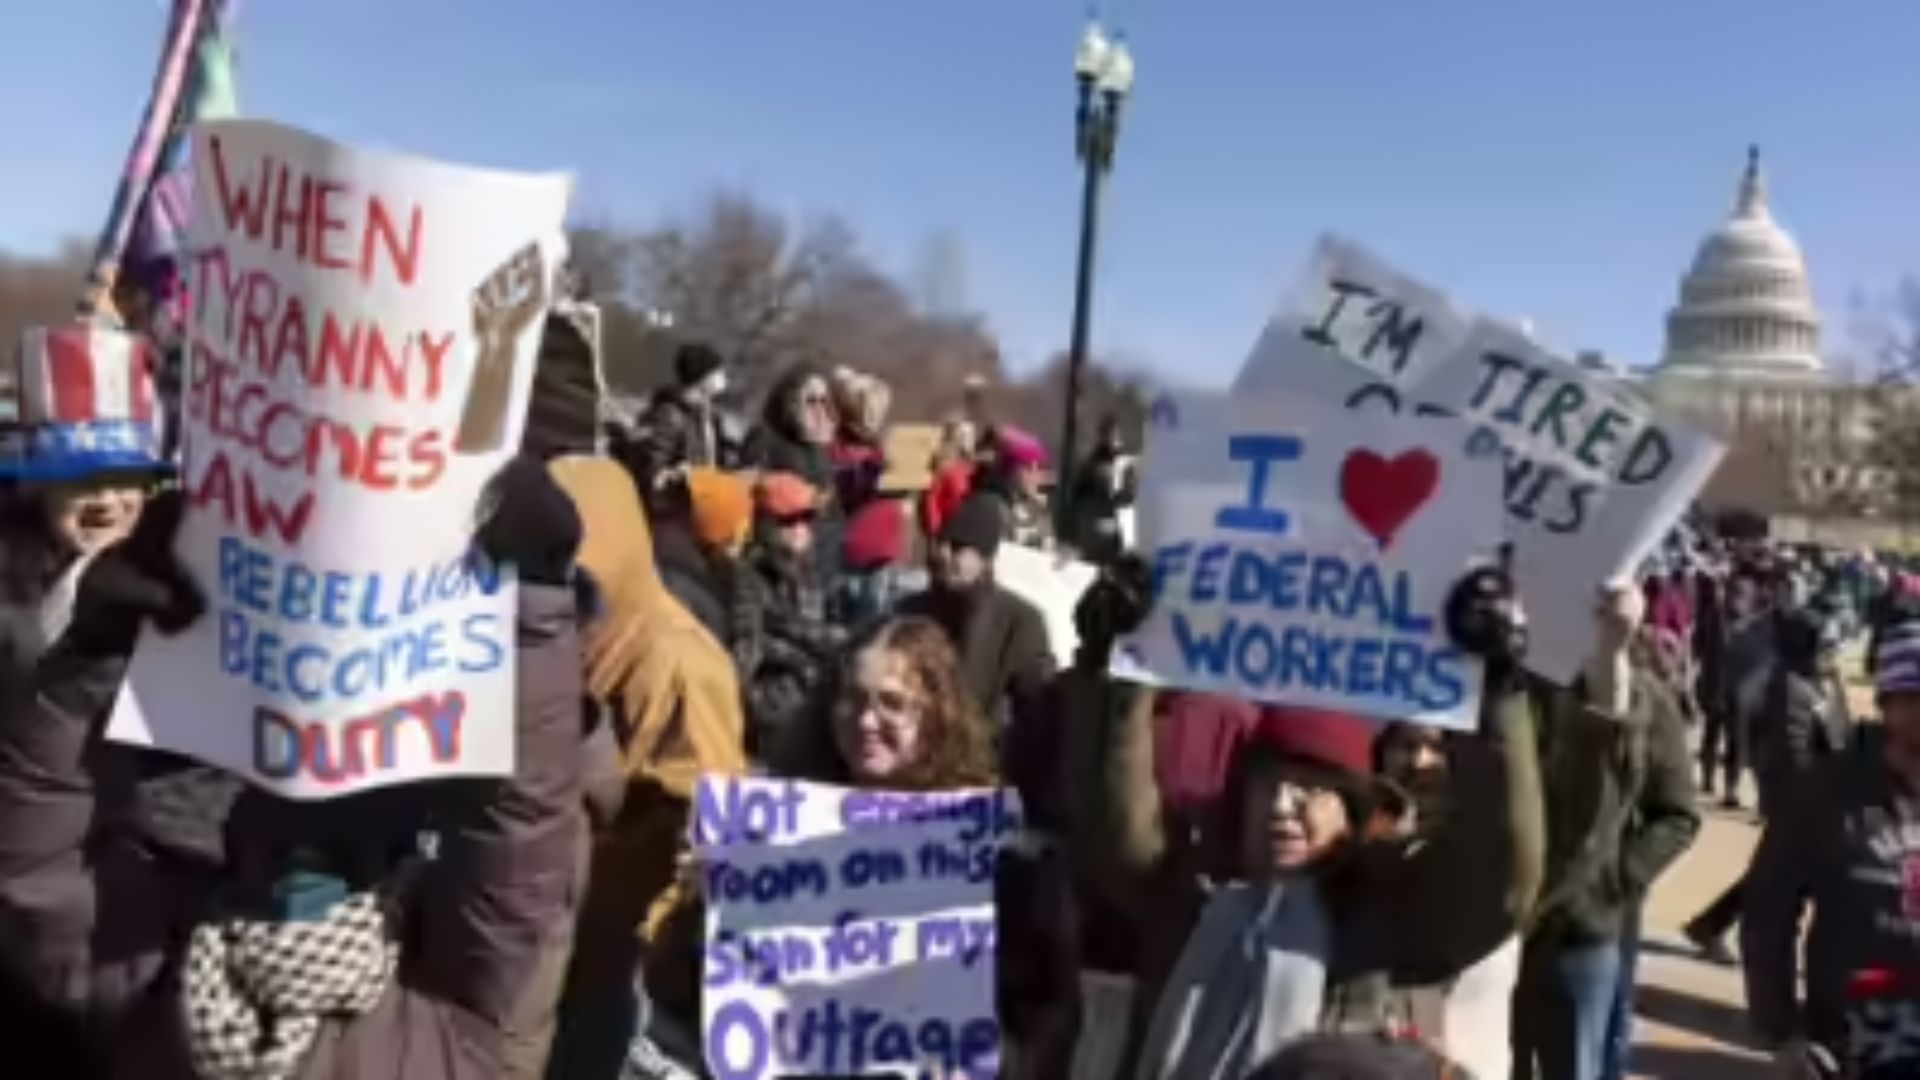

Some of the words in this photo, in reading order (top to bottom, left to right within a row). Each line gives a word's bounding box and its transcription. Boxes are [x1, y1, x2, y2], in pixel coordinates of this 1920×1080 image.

[209, 133, 423, 286] WHEN
[190, 244, 455, 399] TYRANNY
[1301, 279, 1424, 373] I'M
[1468, 350, 1674, 485] TIRED
[1215, 435, 1303, 534] I
[218, 535, 502, 629] REBELLION
[1150, 539, 1434, 634] FEDERAL
[218, 608, 505, 702] BECOMES
[1170, 611, 1465, 712] WORKERS
[252, 690, 467, 784] DUTY
[692, 775, 804, 848] Not
[841, 849, 906, 889] on
[823, 910, 899, 971] for
[914, 915, 995, 967] my
